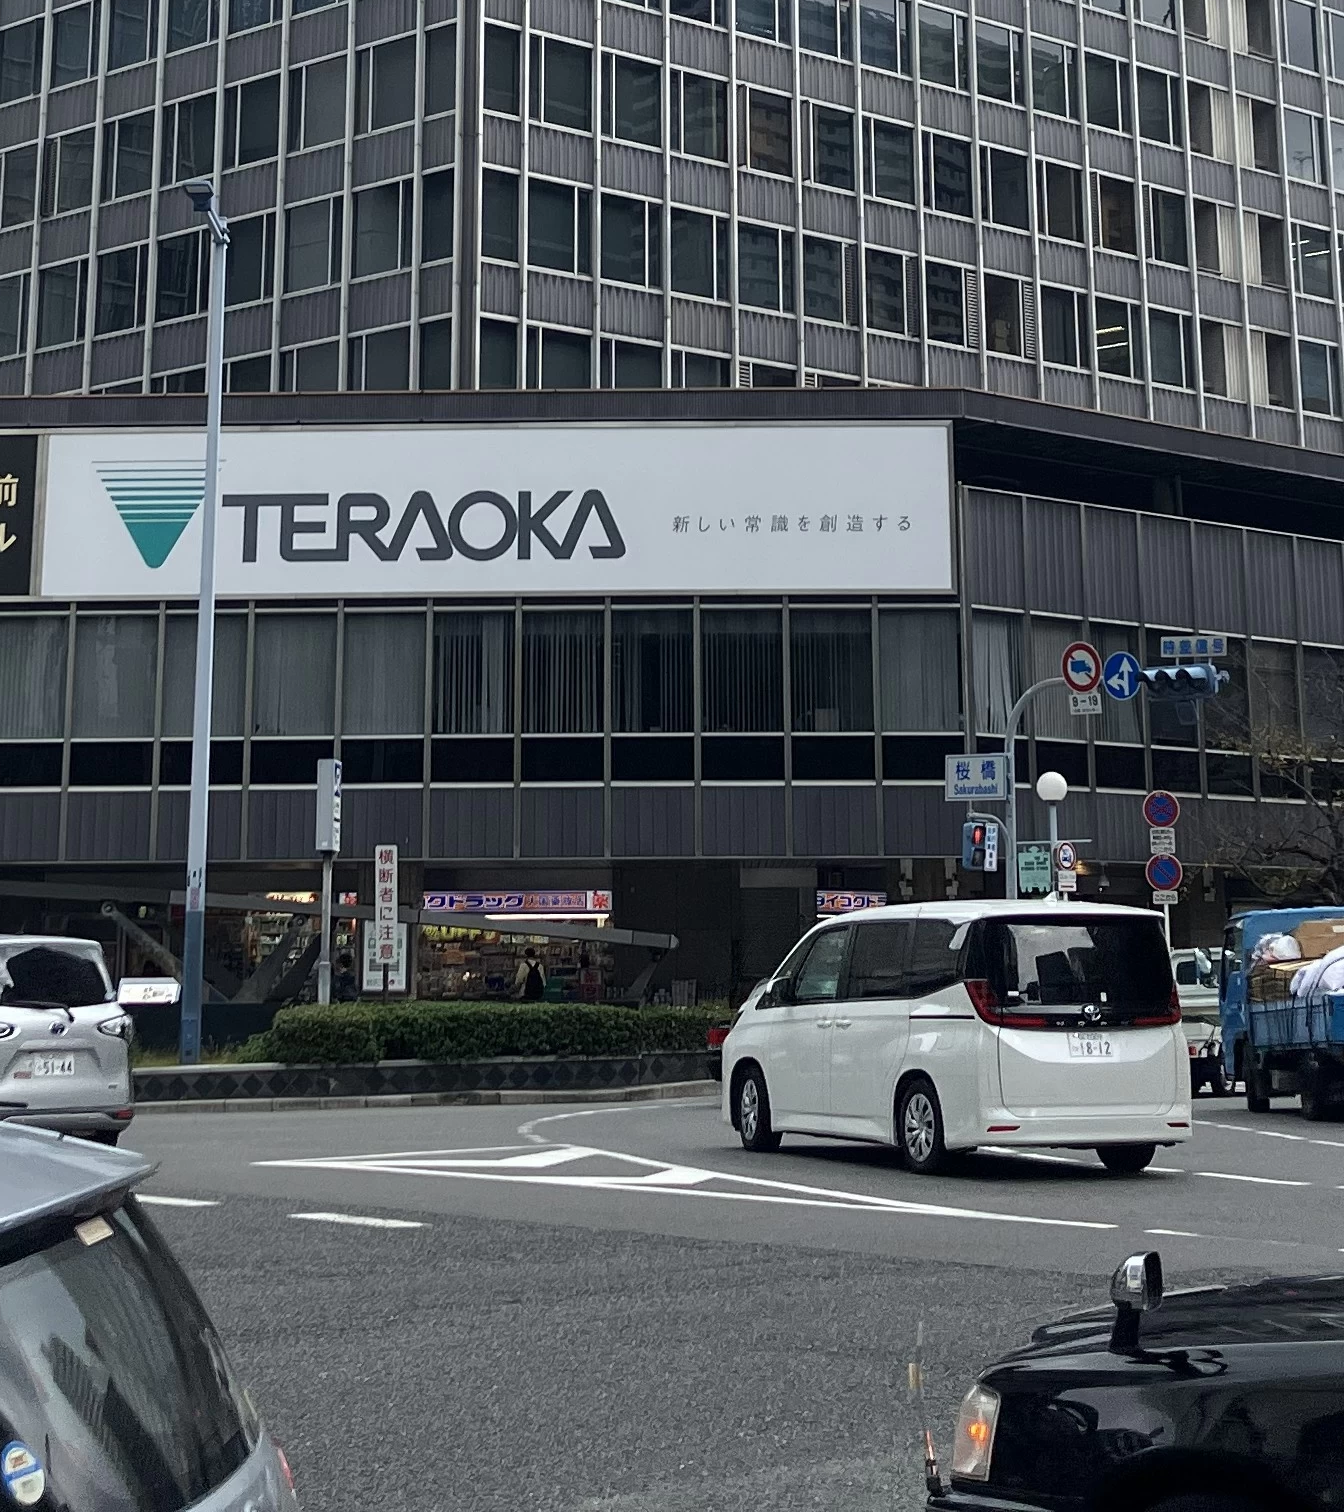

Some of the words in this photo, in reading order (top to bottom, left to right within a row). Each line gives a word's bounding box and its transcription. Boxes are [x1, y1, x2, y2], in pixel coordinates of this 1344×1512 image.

[221, 488, 627, 563] TERAOKA
[672, 514, 912, 533] 新しい常識を創造する
[955, 760, 996, 781] 桜橋
[378, 848, 395, 960] 横断者に注意
